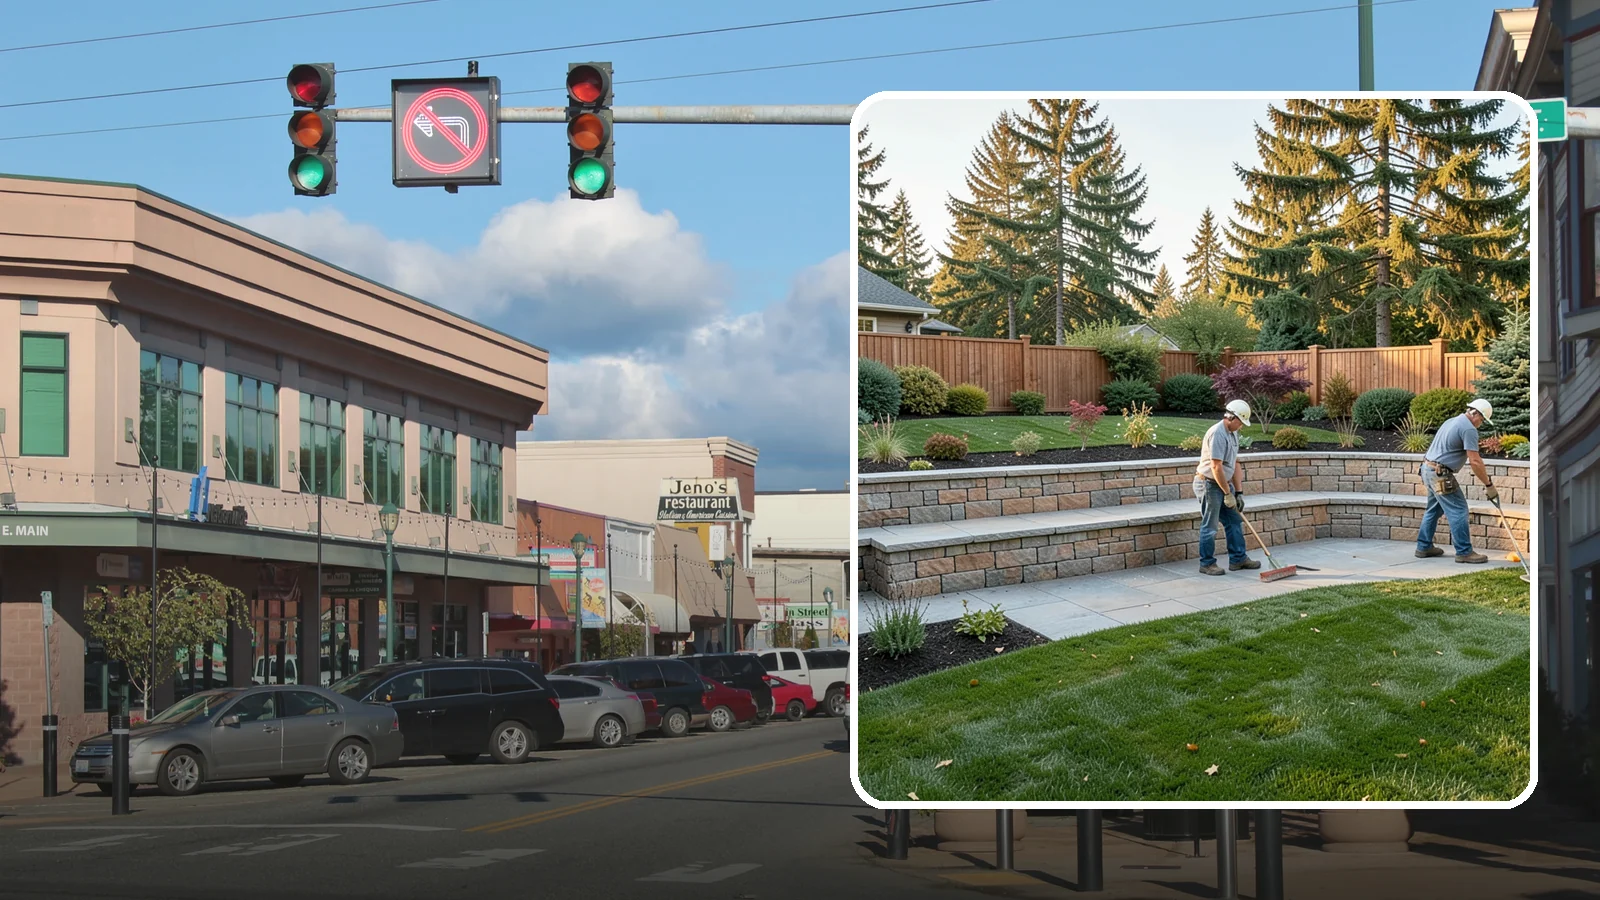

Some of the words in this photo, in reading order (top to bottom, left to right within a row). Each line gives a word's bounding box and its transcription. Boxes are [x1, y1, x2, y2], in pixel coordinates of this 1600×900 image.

[669, 480, 727, 495] Jeno's
[665, 496, 731, 509] restaurant
[658, 509, 682, 519] Italian
[686, 509, 715, 519] American
[715, 509, 738, 519] Cuisine
[2, 525, 13, 536] E.
[15, 525, 49, 536] MAIN
[797, 607, 828, 617] Street
[791, 619, 823, 627] lass
